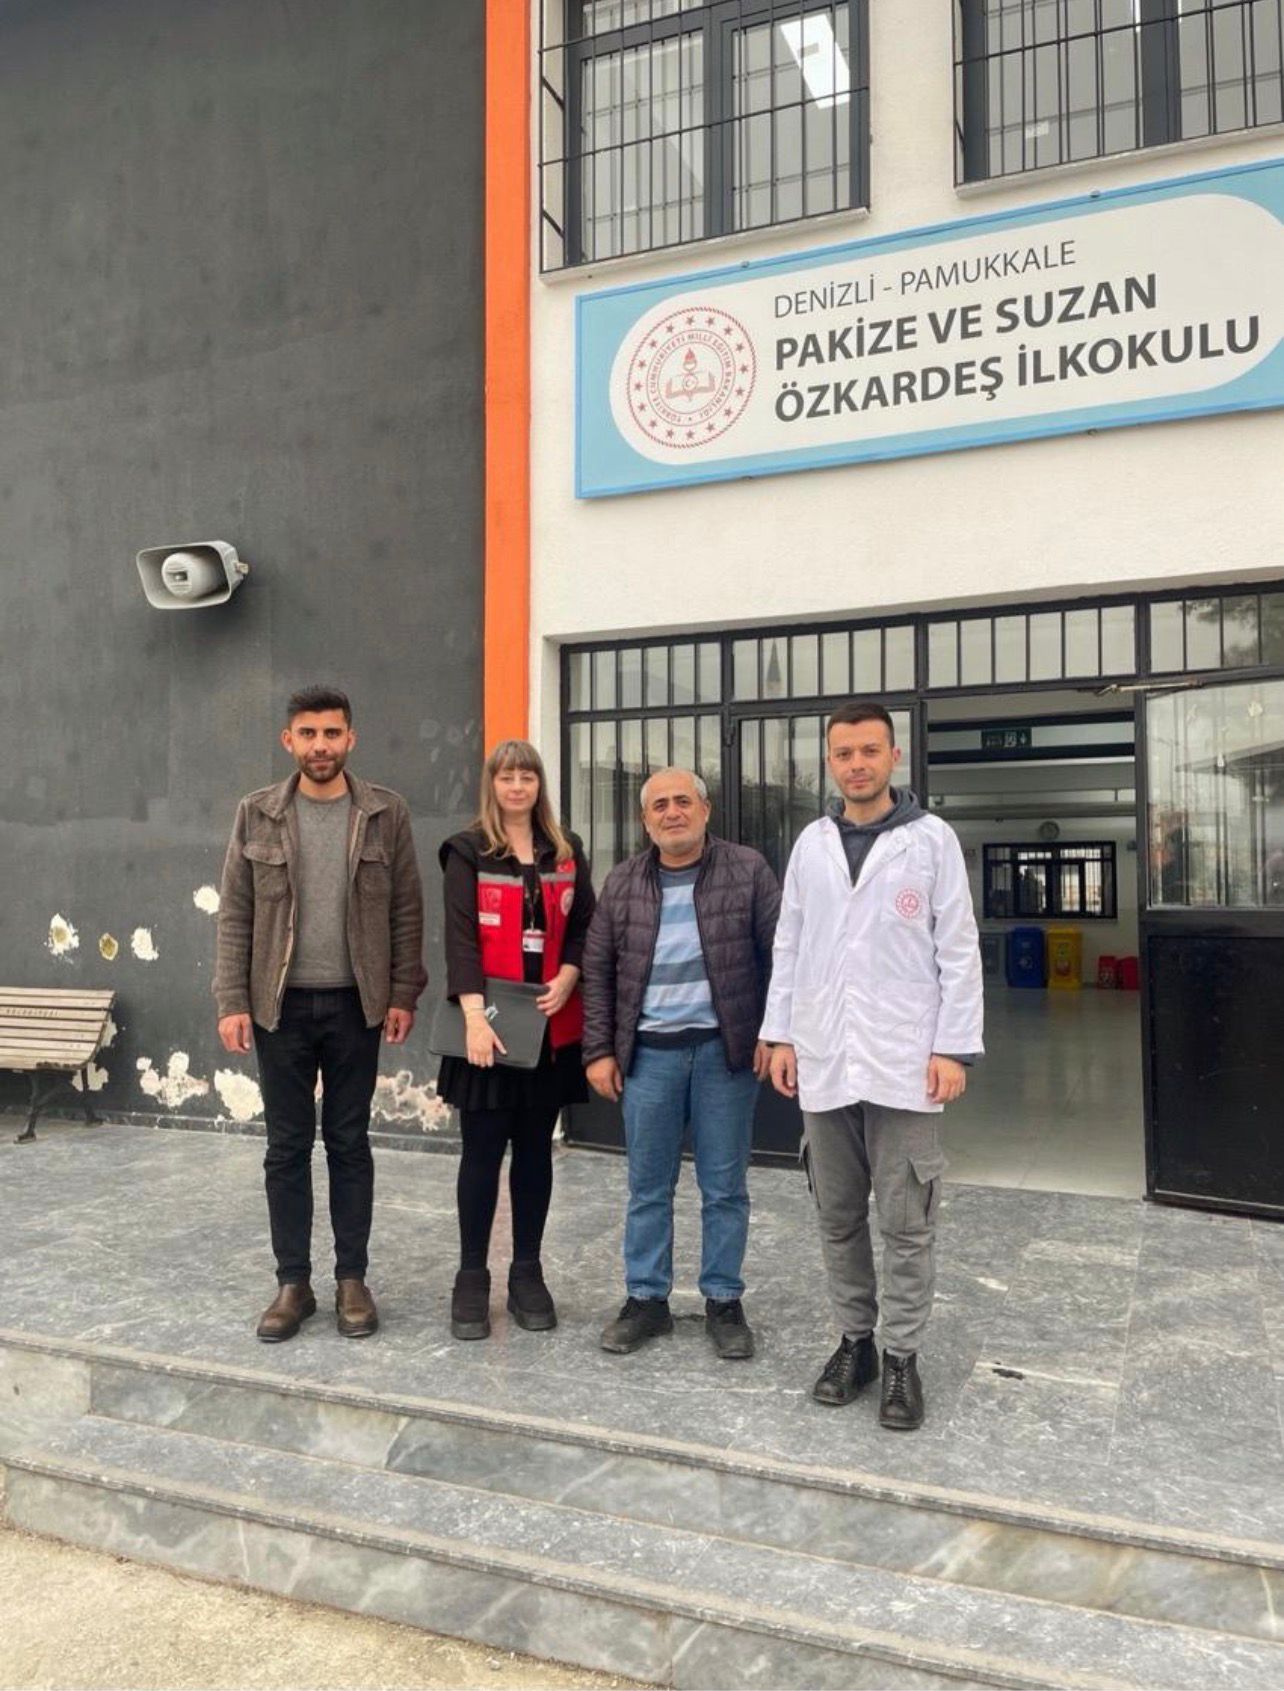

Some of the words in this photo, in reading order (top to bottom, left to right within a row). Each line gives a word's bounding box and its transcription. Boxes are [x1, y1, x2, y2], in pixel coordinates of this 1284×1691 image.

[774, 274, 875, 319] DENİZLİ
[901, 240, 1076, 296] PAMUKKALE
[776, 316, 918, 371] PAKİZE
[927, 303, 983, 344] VE
[996, 273, 1156, 334] SUZAN
[774, 356, 1004, 423] ÖZKARDEŞ
[1018, 315, 1259, 387] İLKOKULU
